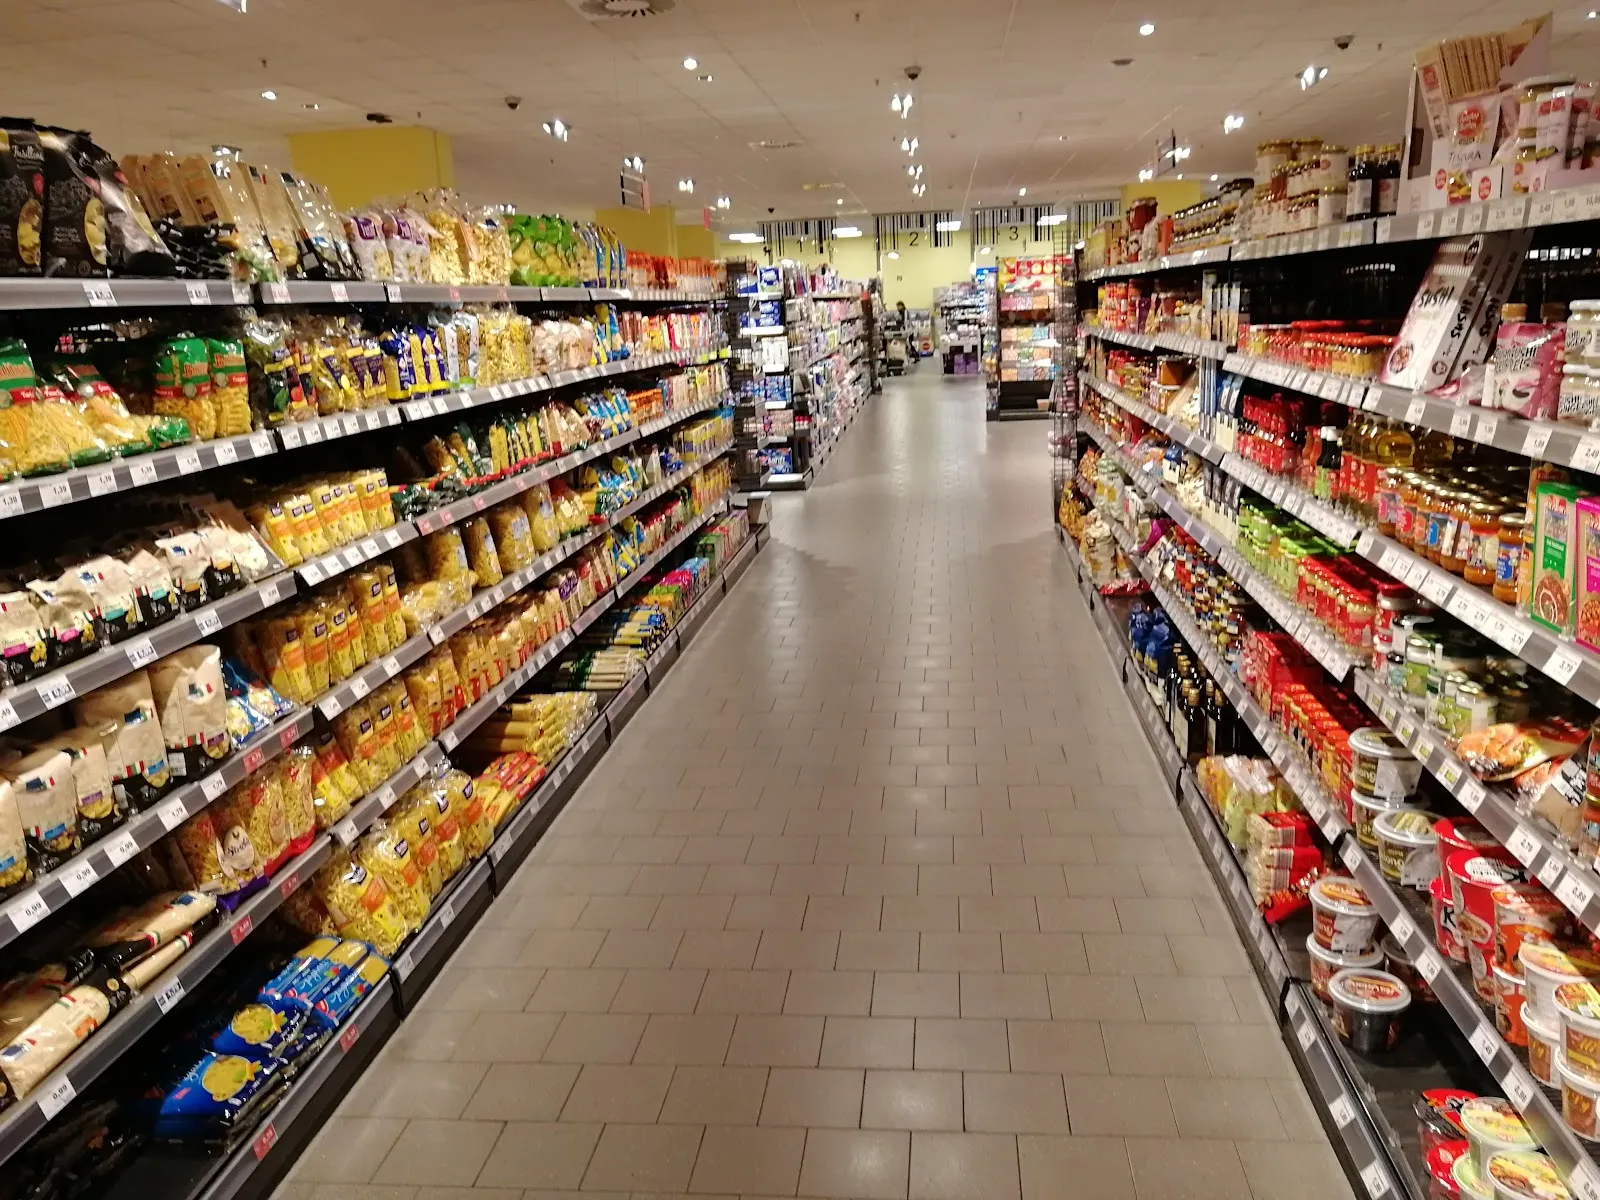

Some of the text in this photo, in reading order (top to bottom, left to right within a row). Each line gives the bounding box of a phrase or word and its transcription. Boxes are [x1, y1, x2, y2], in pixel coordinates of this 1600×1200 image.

[909, 232, 919, 247] 2
[1009, 226, 1019, 240] 3
[1418, 286, 1455, 308] SUSHI
[1451, 300, 1473, 339] SUSHI
[1584, 447, 1600, 460] 2,49
[141, 466, 153, 474] 1,39
[99, 474, 112, 484] 1,39
[53, 485, 67, 495] 1,39
[2, 496, 18, 506] 1,39
[1559, 660, 1574, 674] 3,79
[118, 840, 134, 853] 0,99
[1520, 837, 1534, 853] 2,79
[76, 867, 91, 881] 0,99
[25, 901, 42, 916] 0,99
[52, 1083, 68, 1100] 0,99
